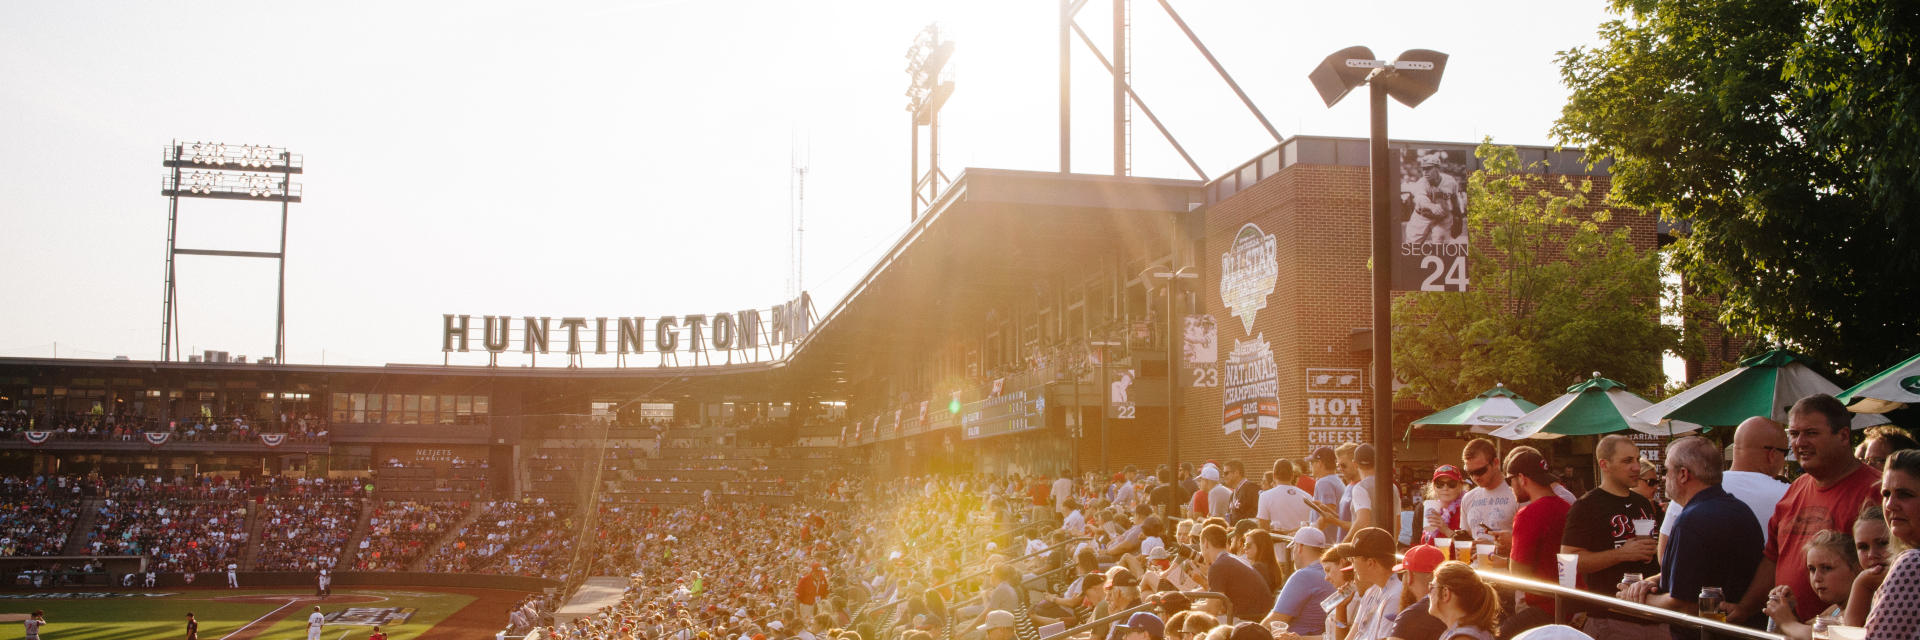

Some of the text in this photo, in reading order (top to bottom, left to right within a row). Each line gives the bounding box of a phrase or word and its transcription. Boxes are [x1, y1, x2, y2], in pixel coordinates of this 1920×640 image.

[1401, 242, 1469, 257] SECTION
[1420, 255, 1470, 292] 24
[442, 311, 758, 355] HUNTINGTON
[1193, 368, 1218, 387] 23
[1226, 356, 1277, 387] NATIONAL
[1225, 379, 1277, 405] CHAMPIONSHIP
[1118, 406, 1136, 419] 22
[1243, 401, 1258, 415] GAME
[1308, 398, 1362, 416] HOT
[1309, 417, 1362, 426] PIZZA
[1309, 431, 1363, 444] CHEESE
[416, 449, 452, 457] NETJETS
